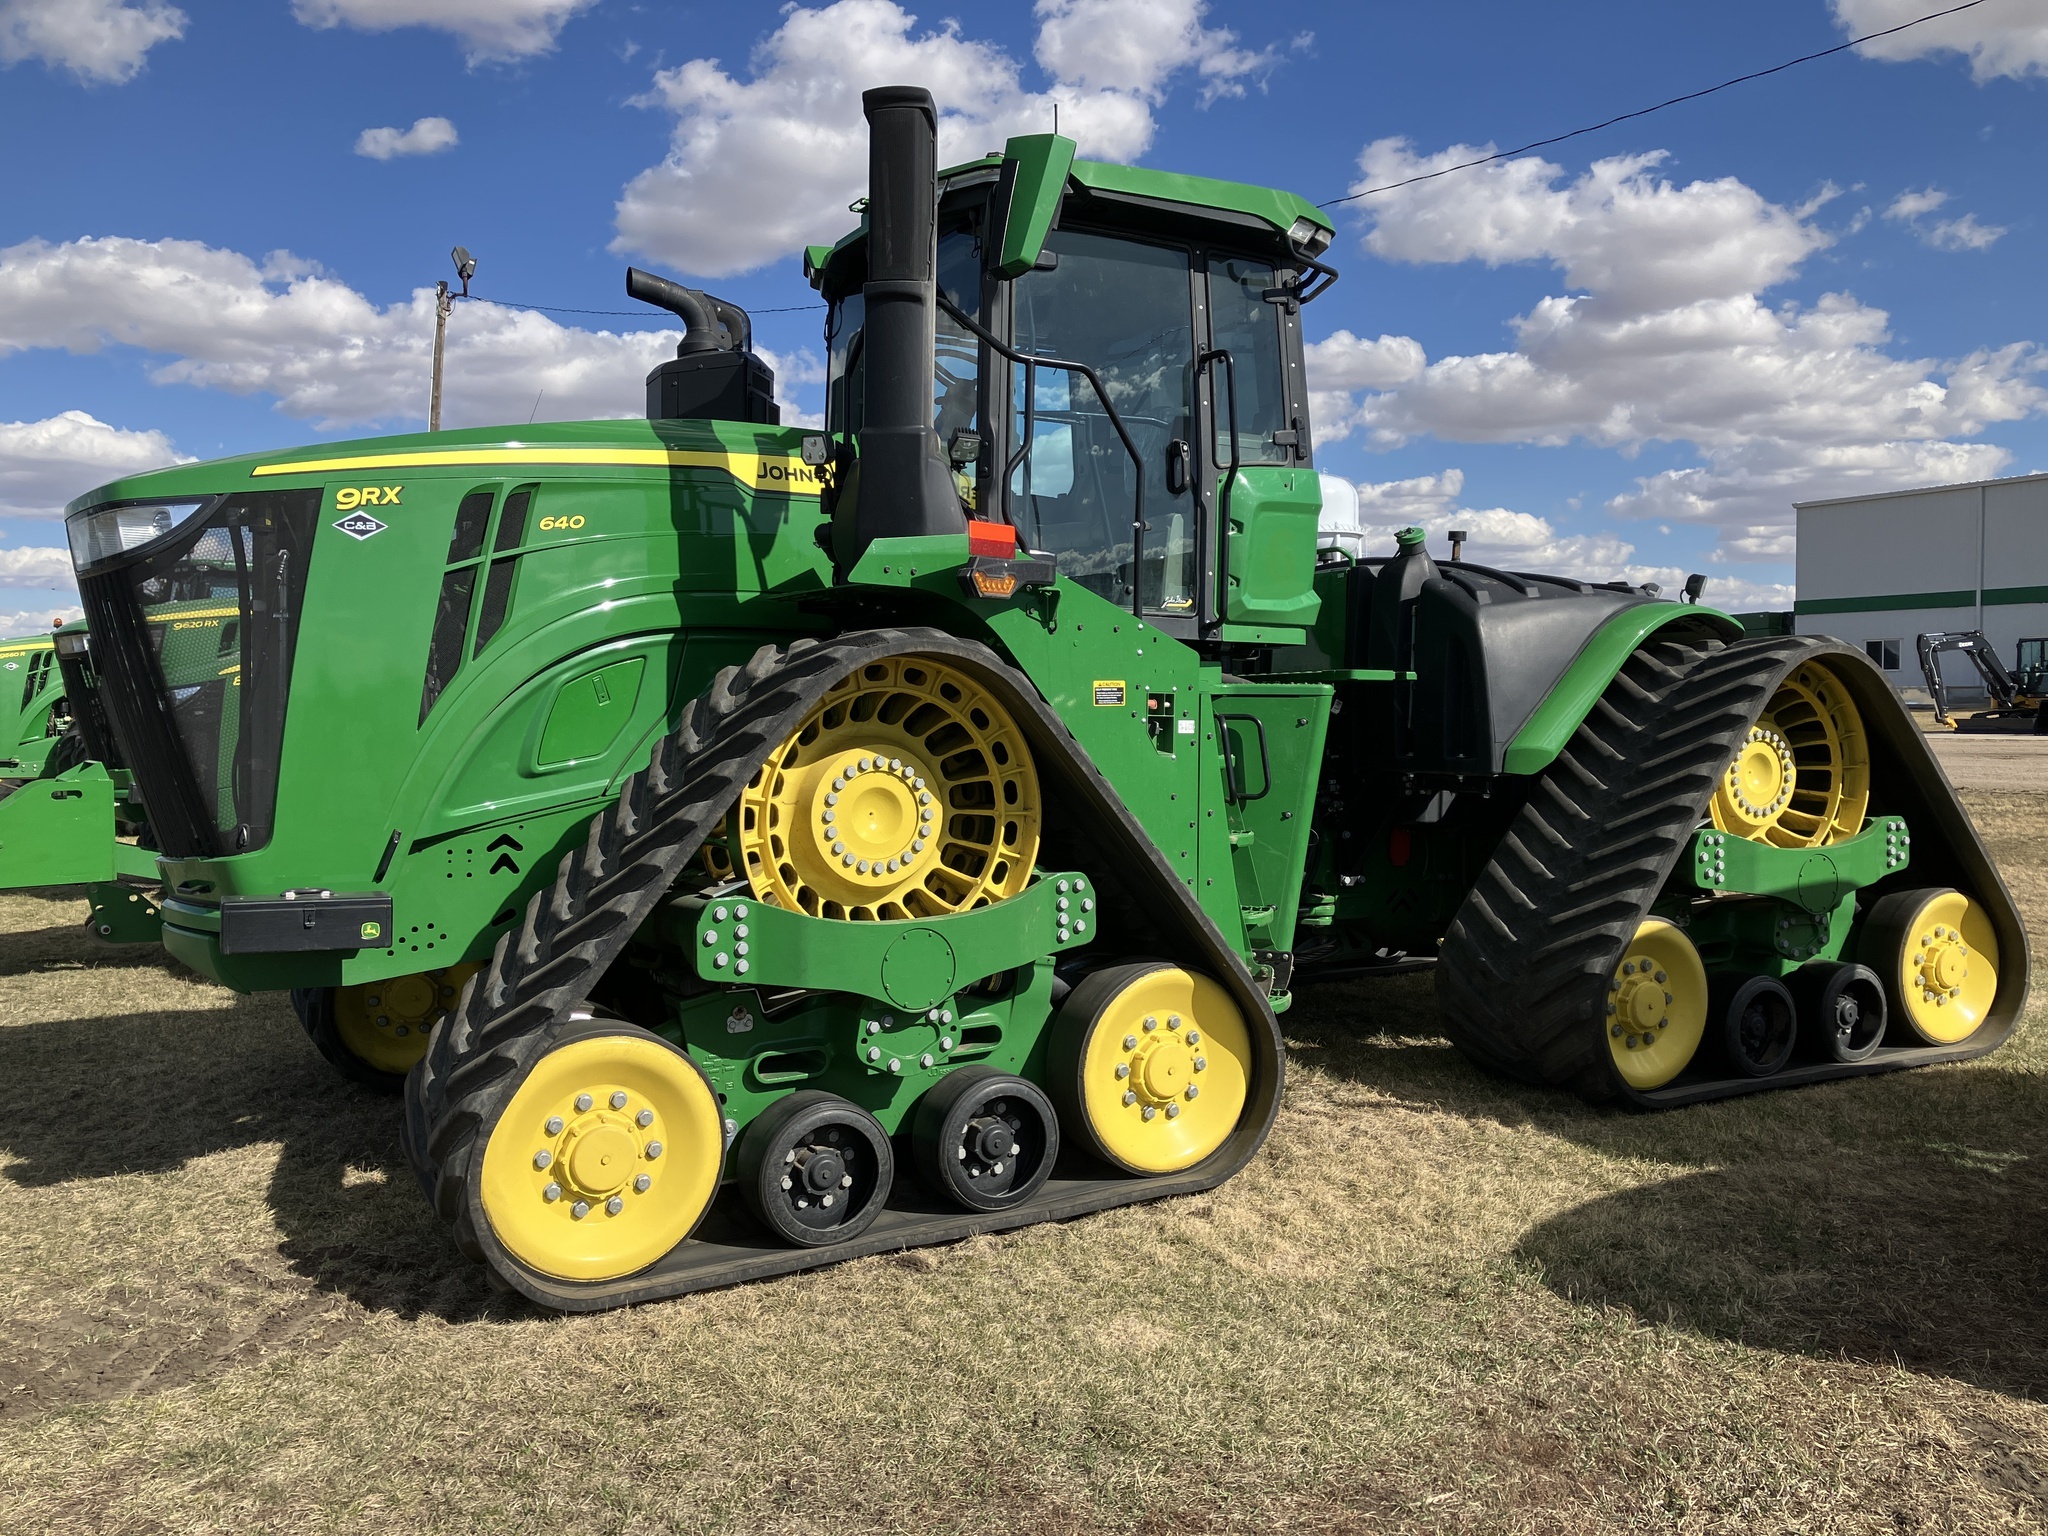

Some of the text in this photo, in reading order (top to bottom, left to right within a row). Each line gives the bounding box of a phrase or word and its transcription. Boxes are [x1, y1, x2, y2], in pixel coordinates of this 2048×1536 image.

[757, 462, 813, 482] JOHN
[336, 486, 403, 510] 9RX
[344, 521, 377, 531] C&B
[539, 514, 586, 531] 640
[173, 621, 203, 631] 9620
